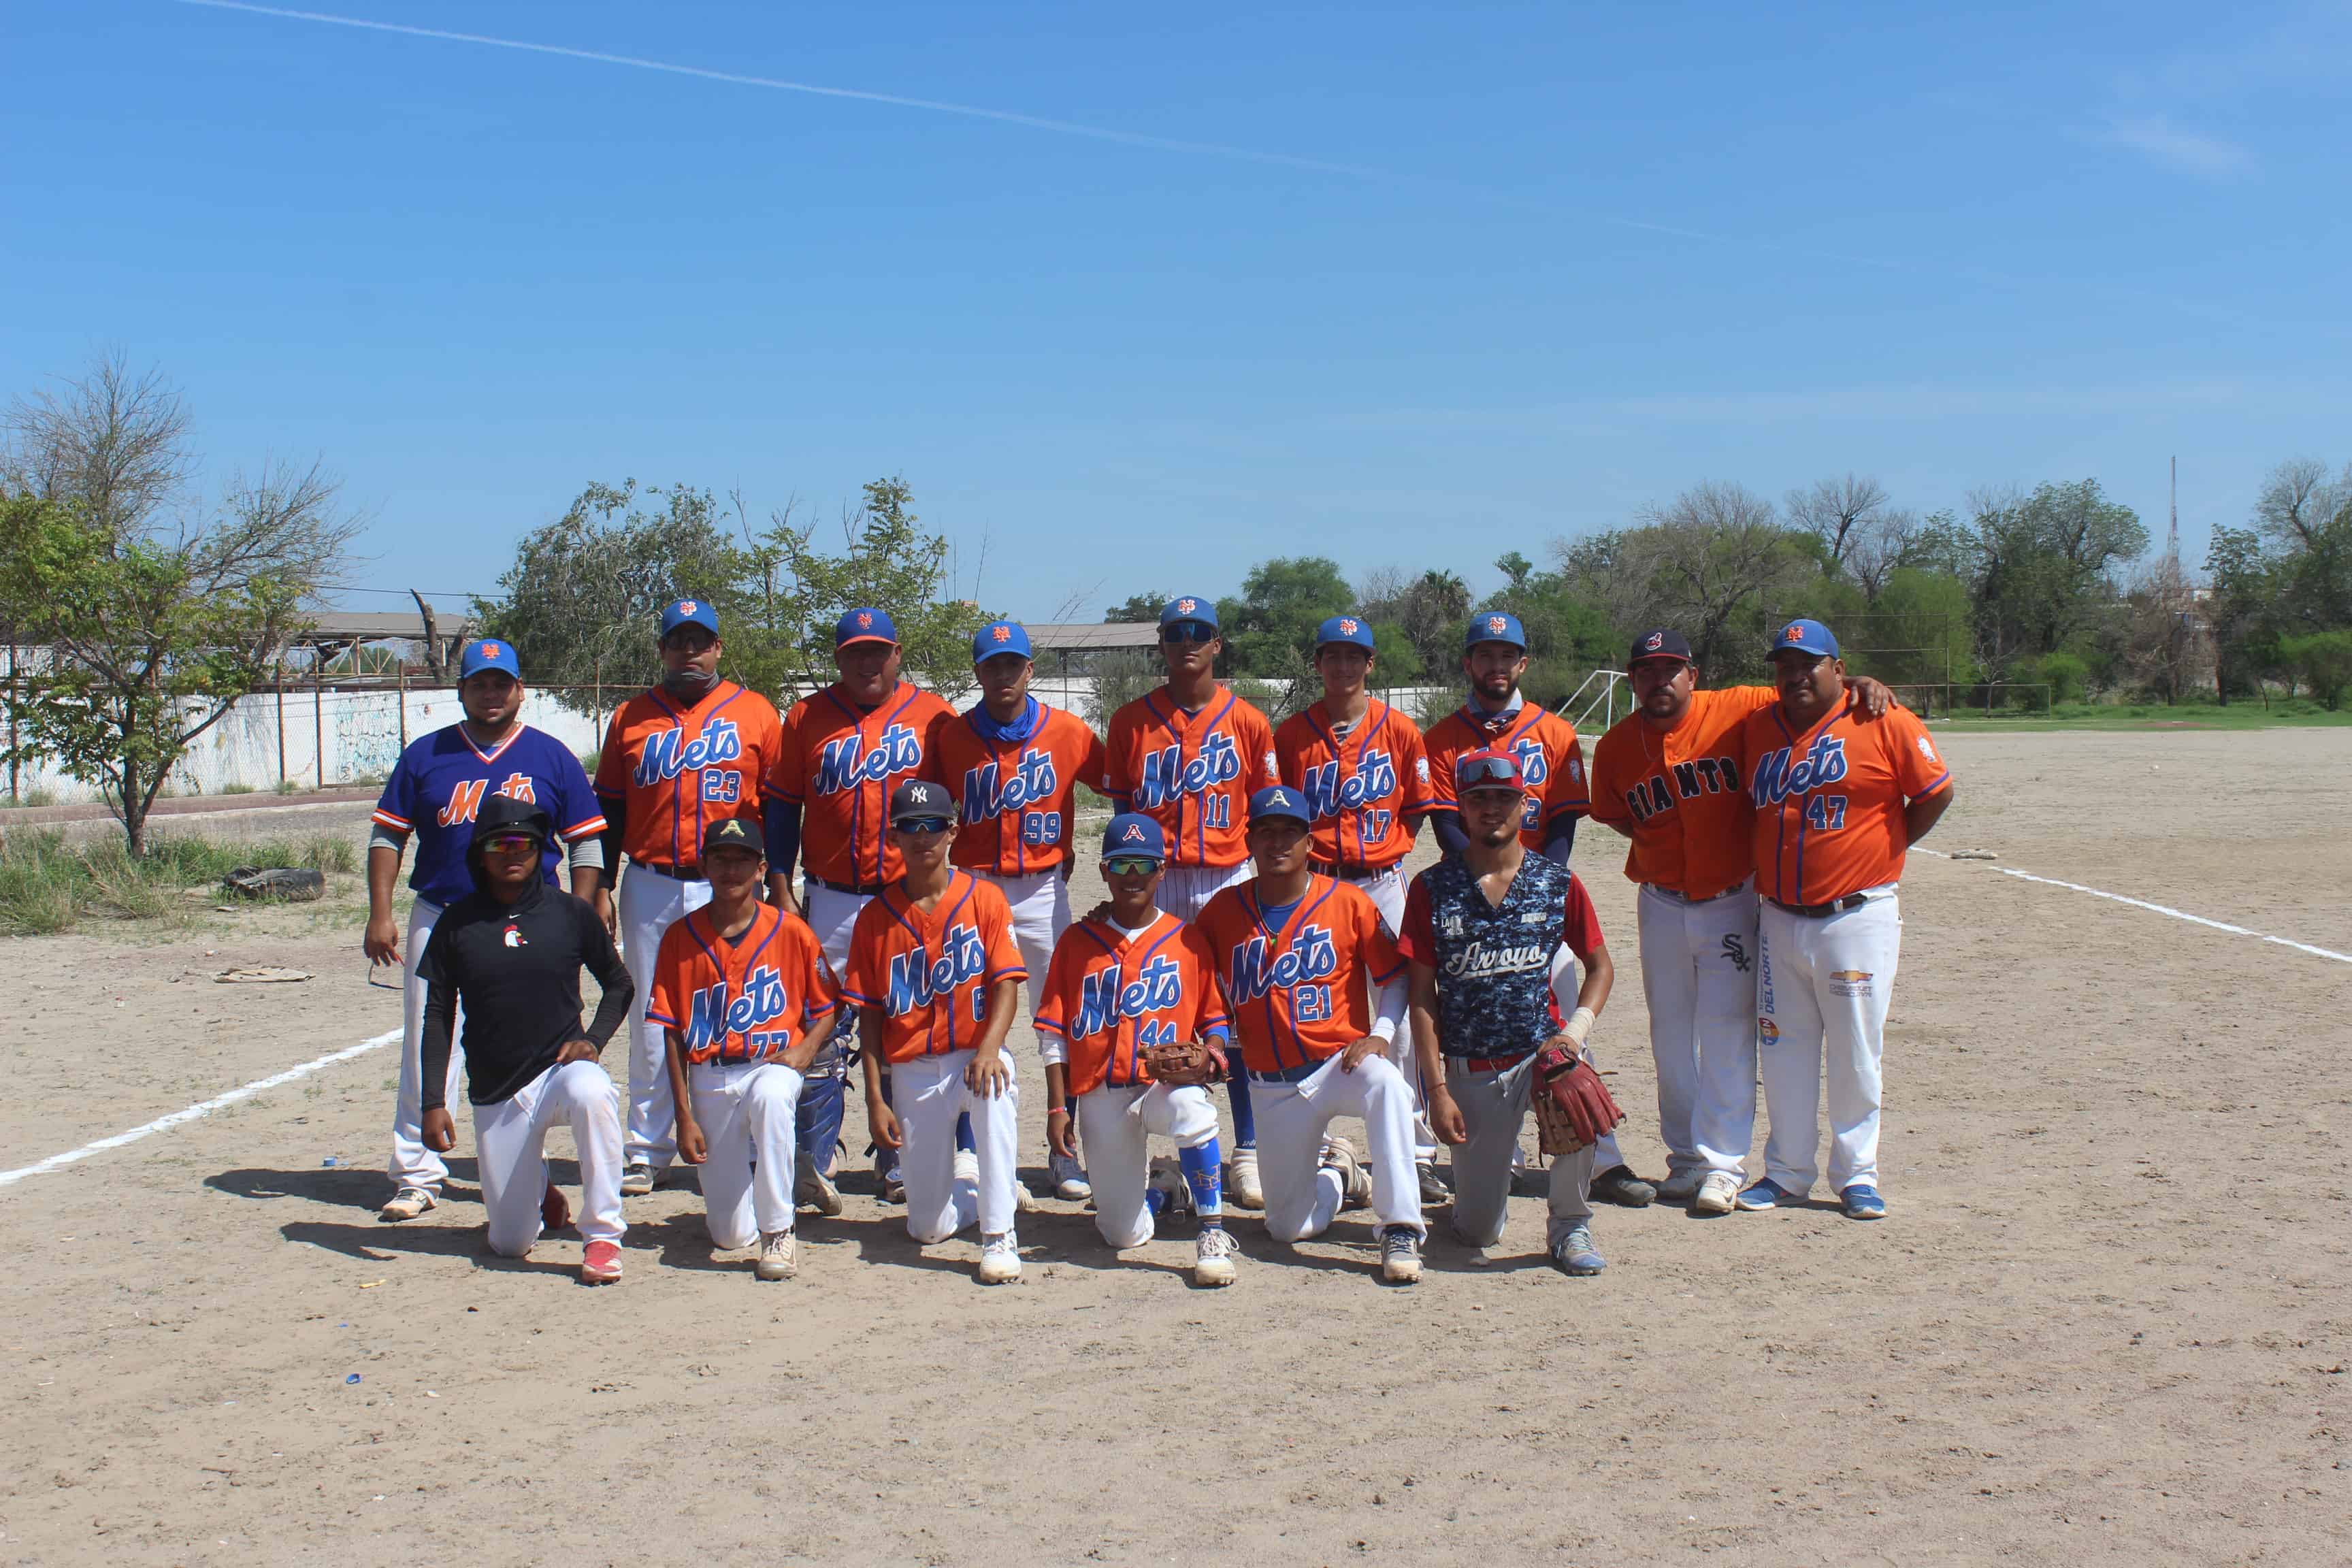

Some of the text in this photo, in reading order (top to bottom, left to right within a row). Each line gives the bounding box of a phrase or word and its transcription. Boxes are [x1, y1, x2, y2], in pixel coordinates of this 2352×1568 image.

[633, 717, 741, 789] Mets
[812, 723, 921, 796] Mets
[1132, 730, 1241, 811] Mets
[1748, 734, 1848, 811] Mets
[438, 772, 536, 828] Mts
[703, 769, 741, 803] 23
[911, 786, 928, 803] NY
[962, 747, 1056, 826] Mets
[1266, 789, 1291, 808] A
[1302, 749, 1396, 822] Mets
[1625, 756, 1740, 823] GIANTS
[720, 819, 745, 838] A
[1024, 811, 1061, 845] 99
[1205, 793, 1230, 828] 11
[1363, 809, 1392, 843] 17
[1806, 795, 1848, 830] 47
[1122, 823, 1145, 842] A
[882, 922, 986, 1019] Mets
[1226, 924, 1337, 1008] Mets
[1720, 933, 1750, 973] Sox
[682, 964, 787, 1054] Mets
[1071, 954, 1181, 1041] Mets
[1296, 984, 1333, 1023] 21
[1765, 988, 1775, 1014] DEL
[751, 1029, 789, 1059] 77
[1139, 1019, 1176, 1048] 44
